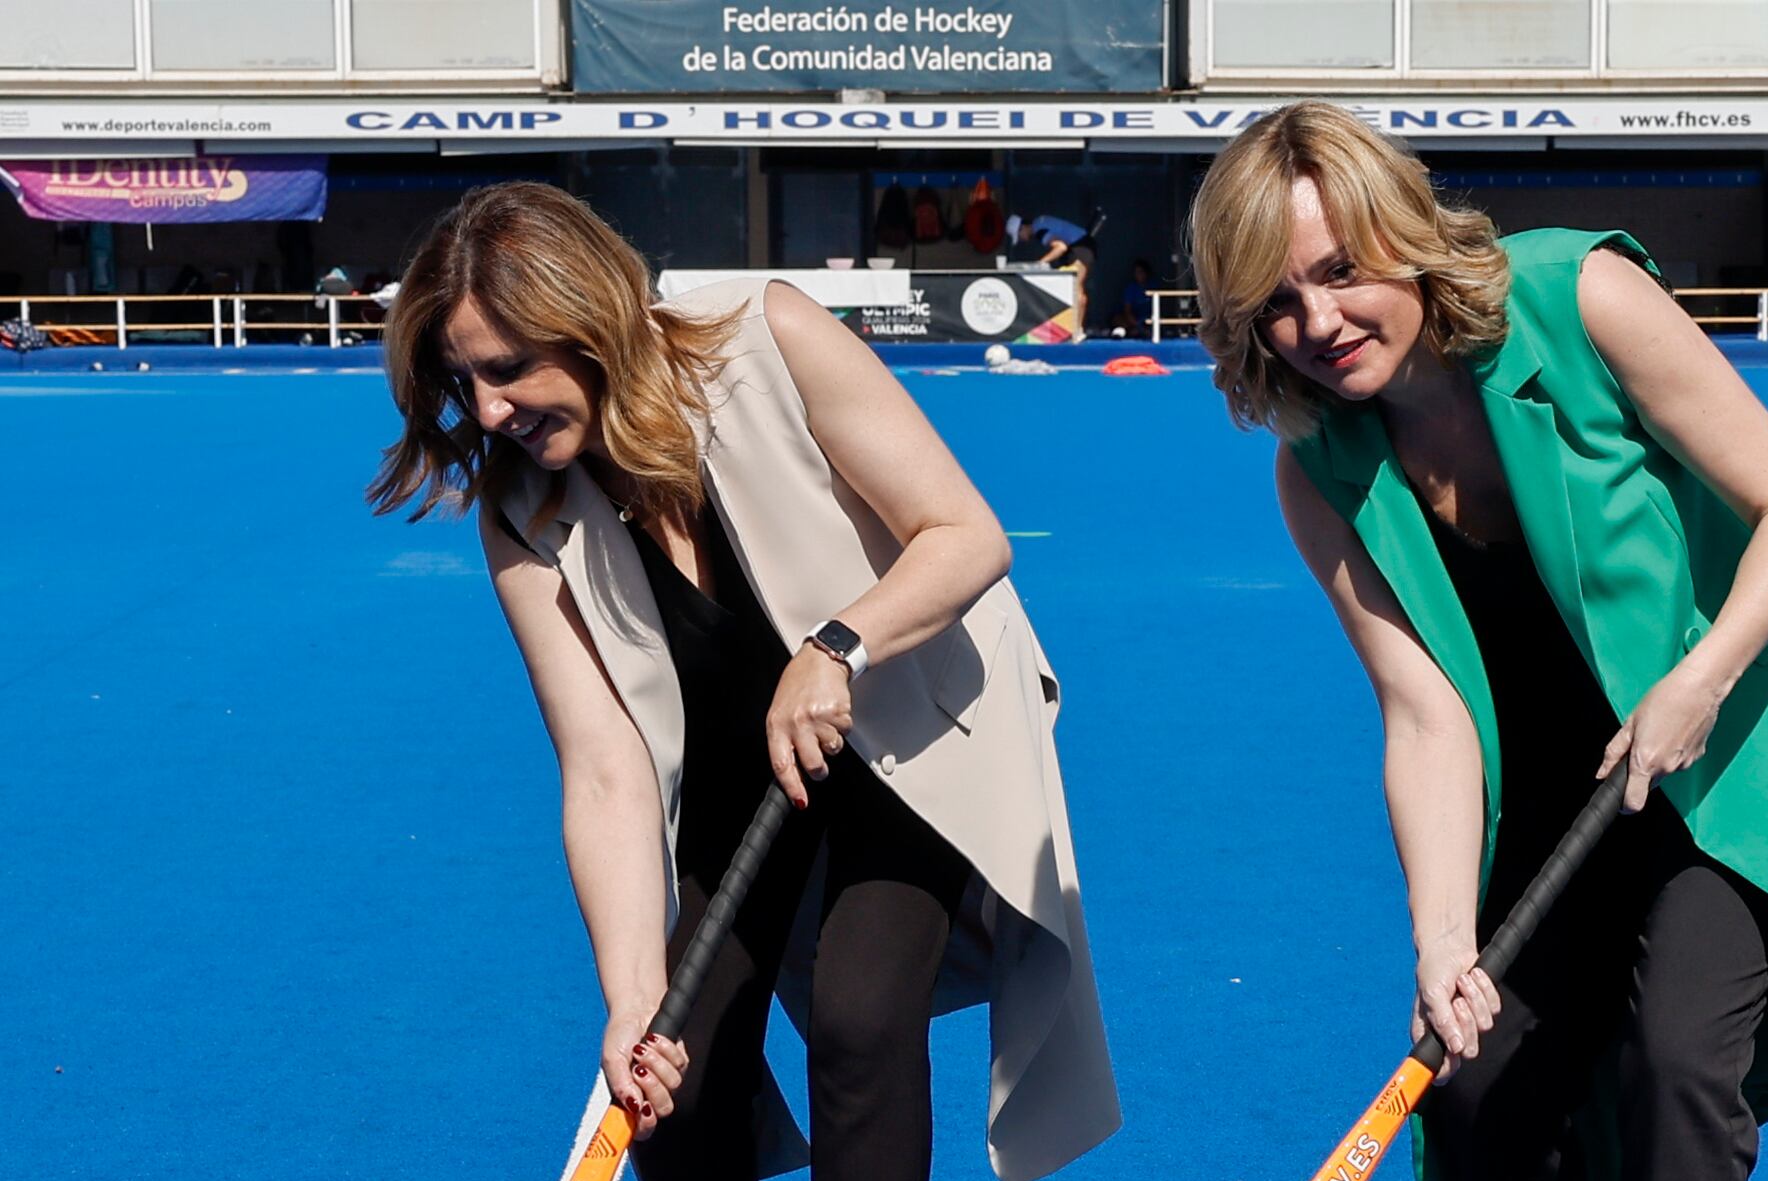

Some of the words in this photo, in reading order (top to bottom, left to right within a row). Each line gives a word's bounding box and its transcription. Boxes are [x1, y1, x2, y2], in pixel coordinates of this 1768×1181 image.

[723, 7, 867, 33] Federación
[874, 7, 909, 33] de
[915, 7, 1013, 39] Hockey
[682, 46, 718, 72] de
[724, 46, 746, 71] la
[752, 45, 905, 71] Comunidad
[910, 45, 1053, 71] Valenciana
[62, 118, 272, 134] www.deportevalencia.com
[345, 111, 563, 130] CAMP
[723, 110, 1025, 130] HOQUEI
[1059, 110, 1155, 129] DE
[1620, 108, 1752, 128] www.fhcv.es
[871, 323, 929, 335] VALENCIA
